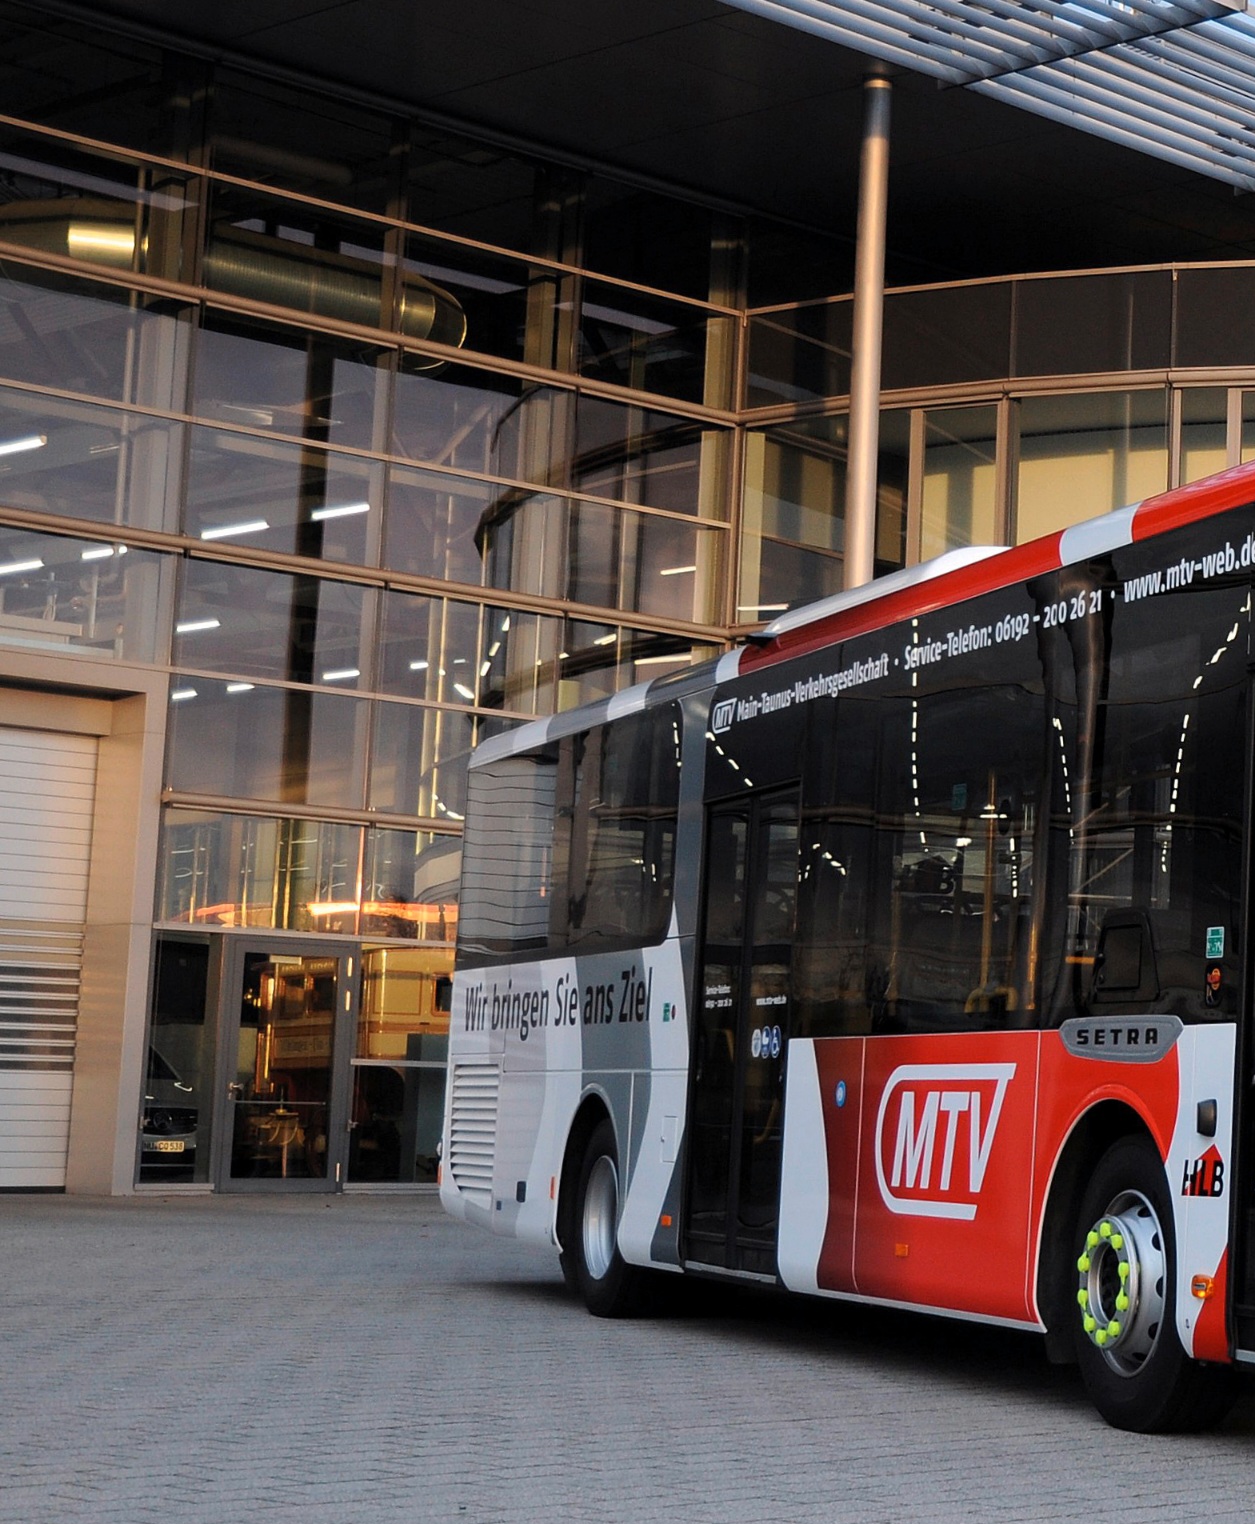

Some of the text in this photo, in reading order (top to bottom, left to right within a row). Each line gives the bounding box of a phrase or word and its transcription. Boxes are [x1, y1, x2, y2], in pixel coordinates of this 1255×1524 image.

[714, 700, 737, 728] MTV
[737, 653, 889, 721] Main-Taunus-Verkehrsgesellschaft
[904, 625, 992, 670] Service-Telefon:
[995, 613, 1029, 642] 06192
[1043, 601, 1067, 628] 200
[1070, 590, 1085, 620] 26
[1089, 589, 1102, 614] 21
[465, 965, 653, 1041] Wir bringen Sie ans Ziel
[1077, 1028, 1158, 1045] SETRA
[891, 1070, 1013, 1193] MTV
[1182, 1160, 1225, 1197] HLB
